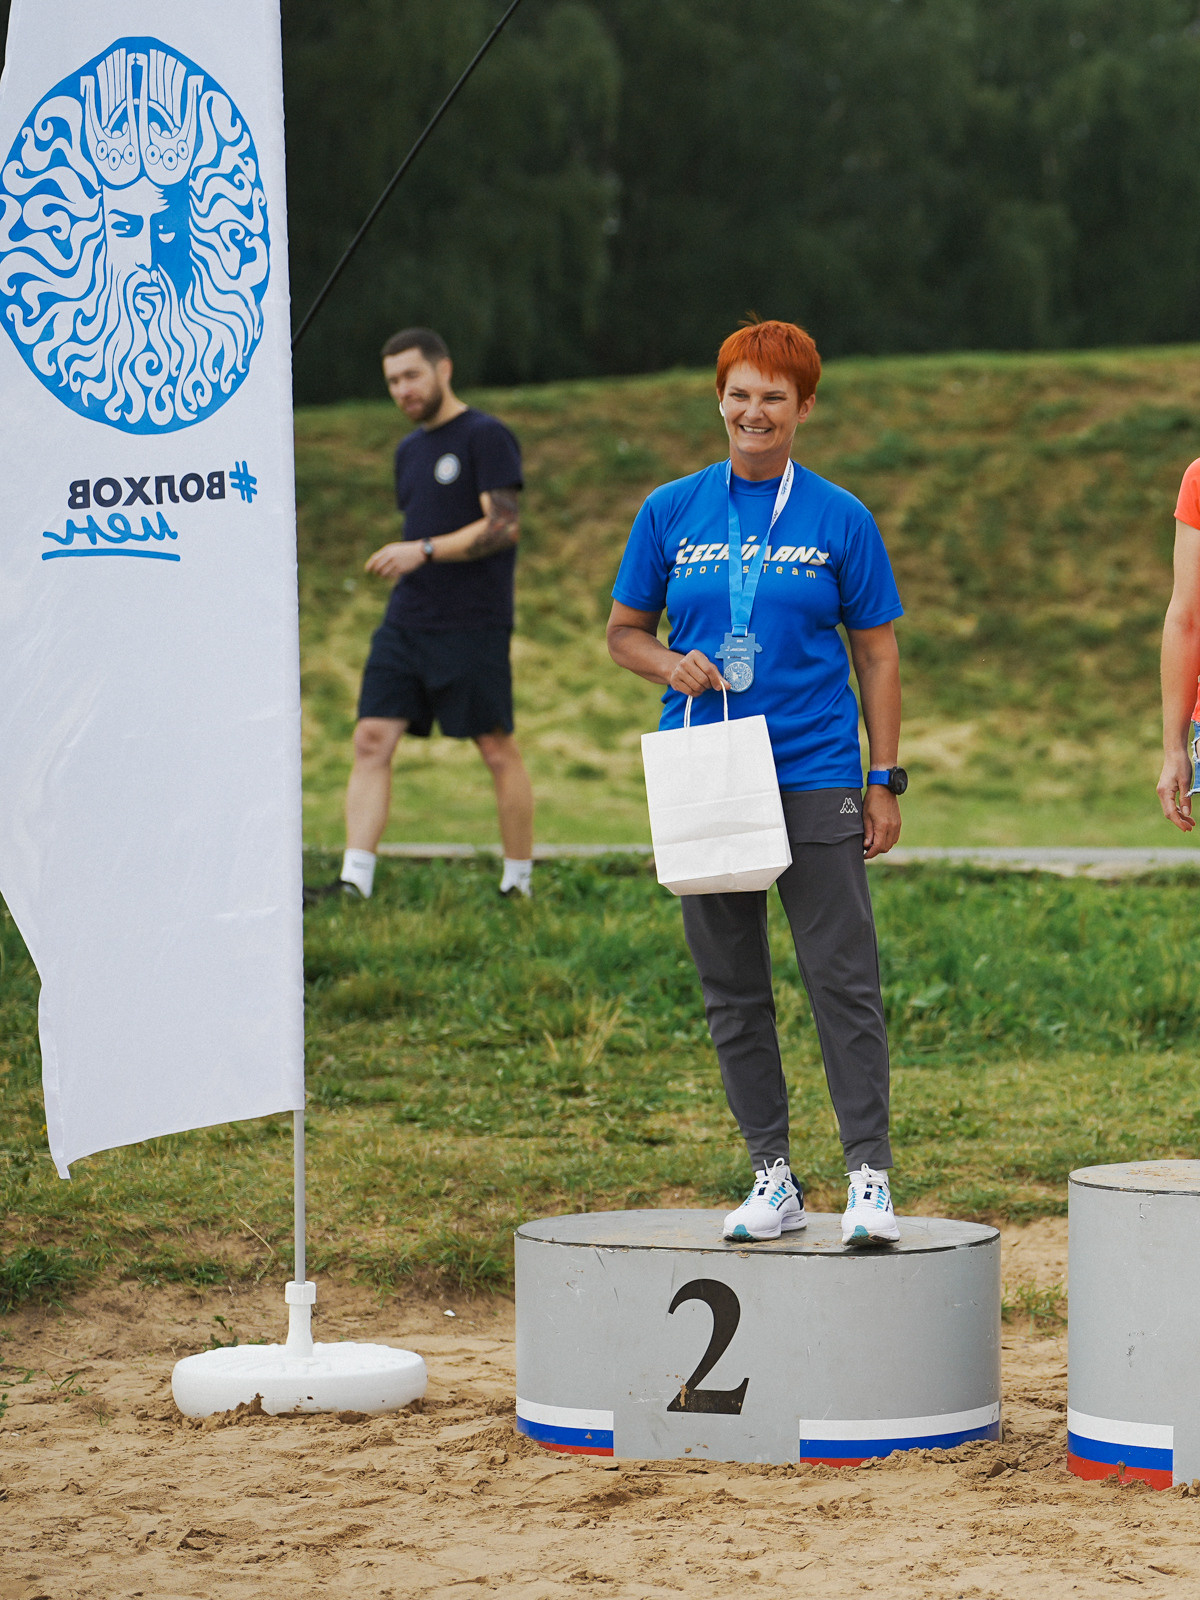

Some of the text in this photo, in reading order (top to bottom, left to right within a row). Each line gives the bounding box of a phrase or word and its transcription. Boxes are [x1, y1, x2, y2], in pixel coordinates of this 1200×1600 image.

[674, 563, 817, 579] Spors Team
[666, 1278, 750, 1416] 2
